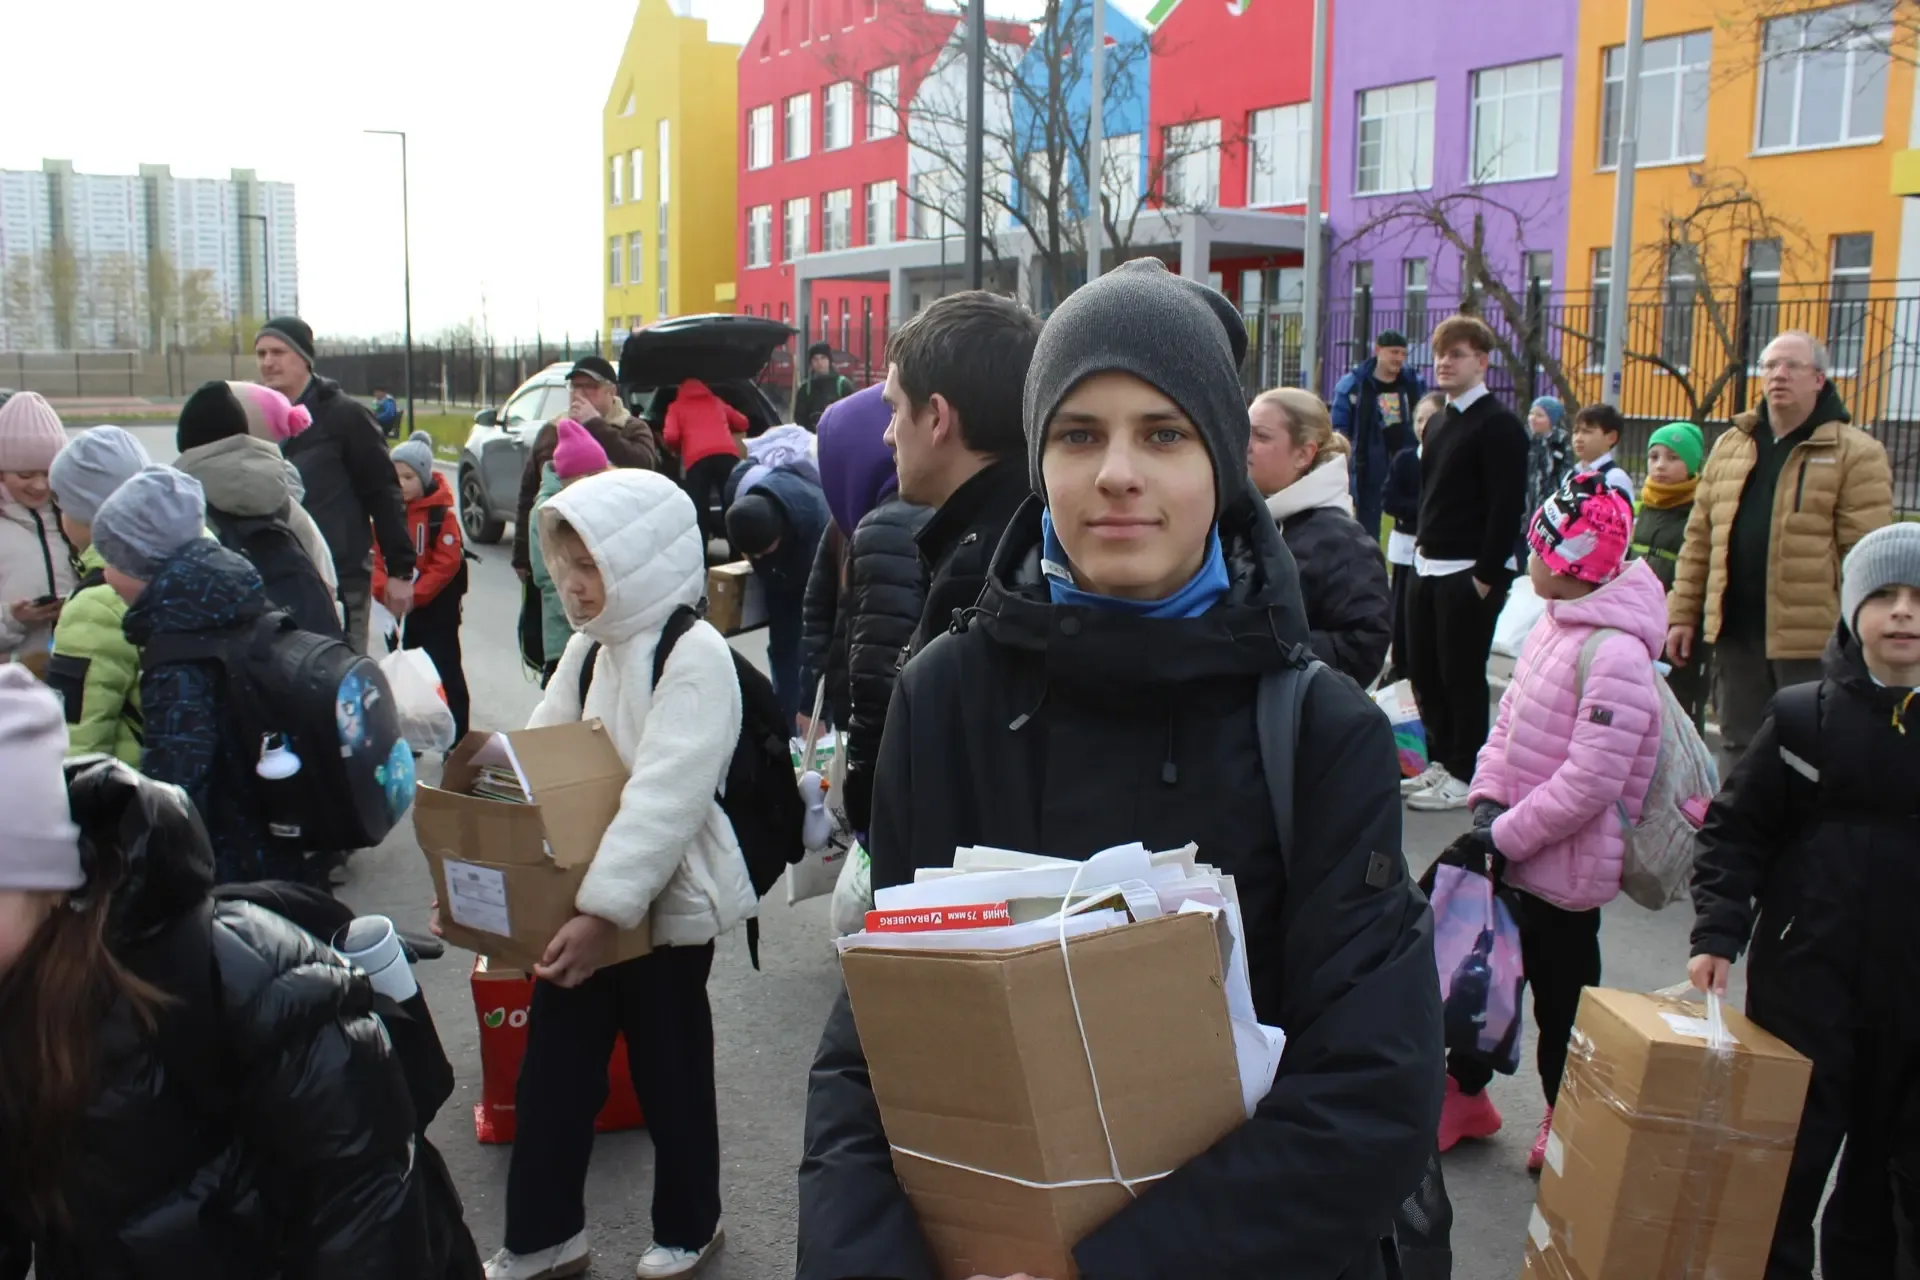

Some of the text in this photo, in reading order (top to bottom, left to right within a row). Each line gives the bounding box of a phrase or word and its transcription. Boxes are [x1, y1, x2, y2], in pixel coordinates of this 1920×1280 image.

[1534, 518, 1556, 547] LIFE
[880, 913, 930, 926] BRAUBERG
[948, 912, 965, 920] мкм
[967, 911, 977, 920] 75
